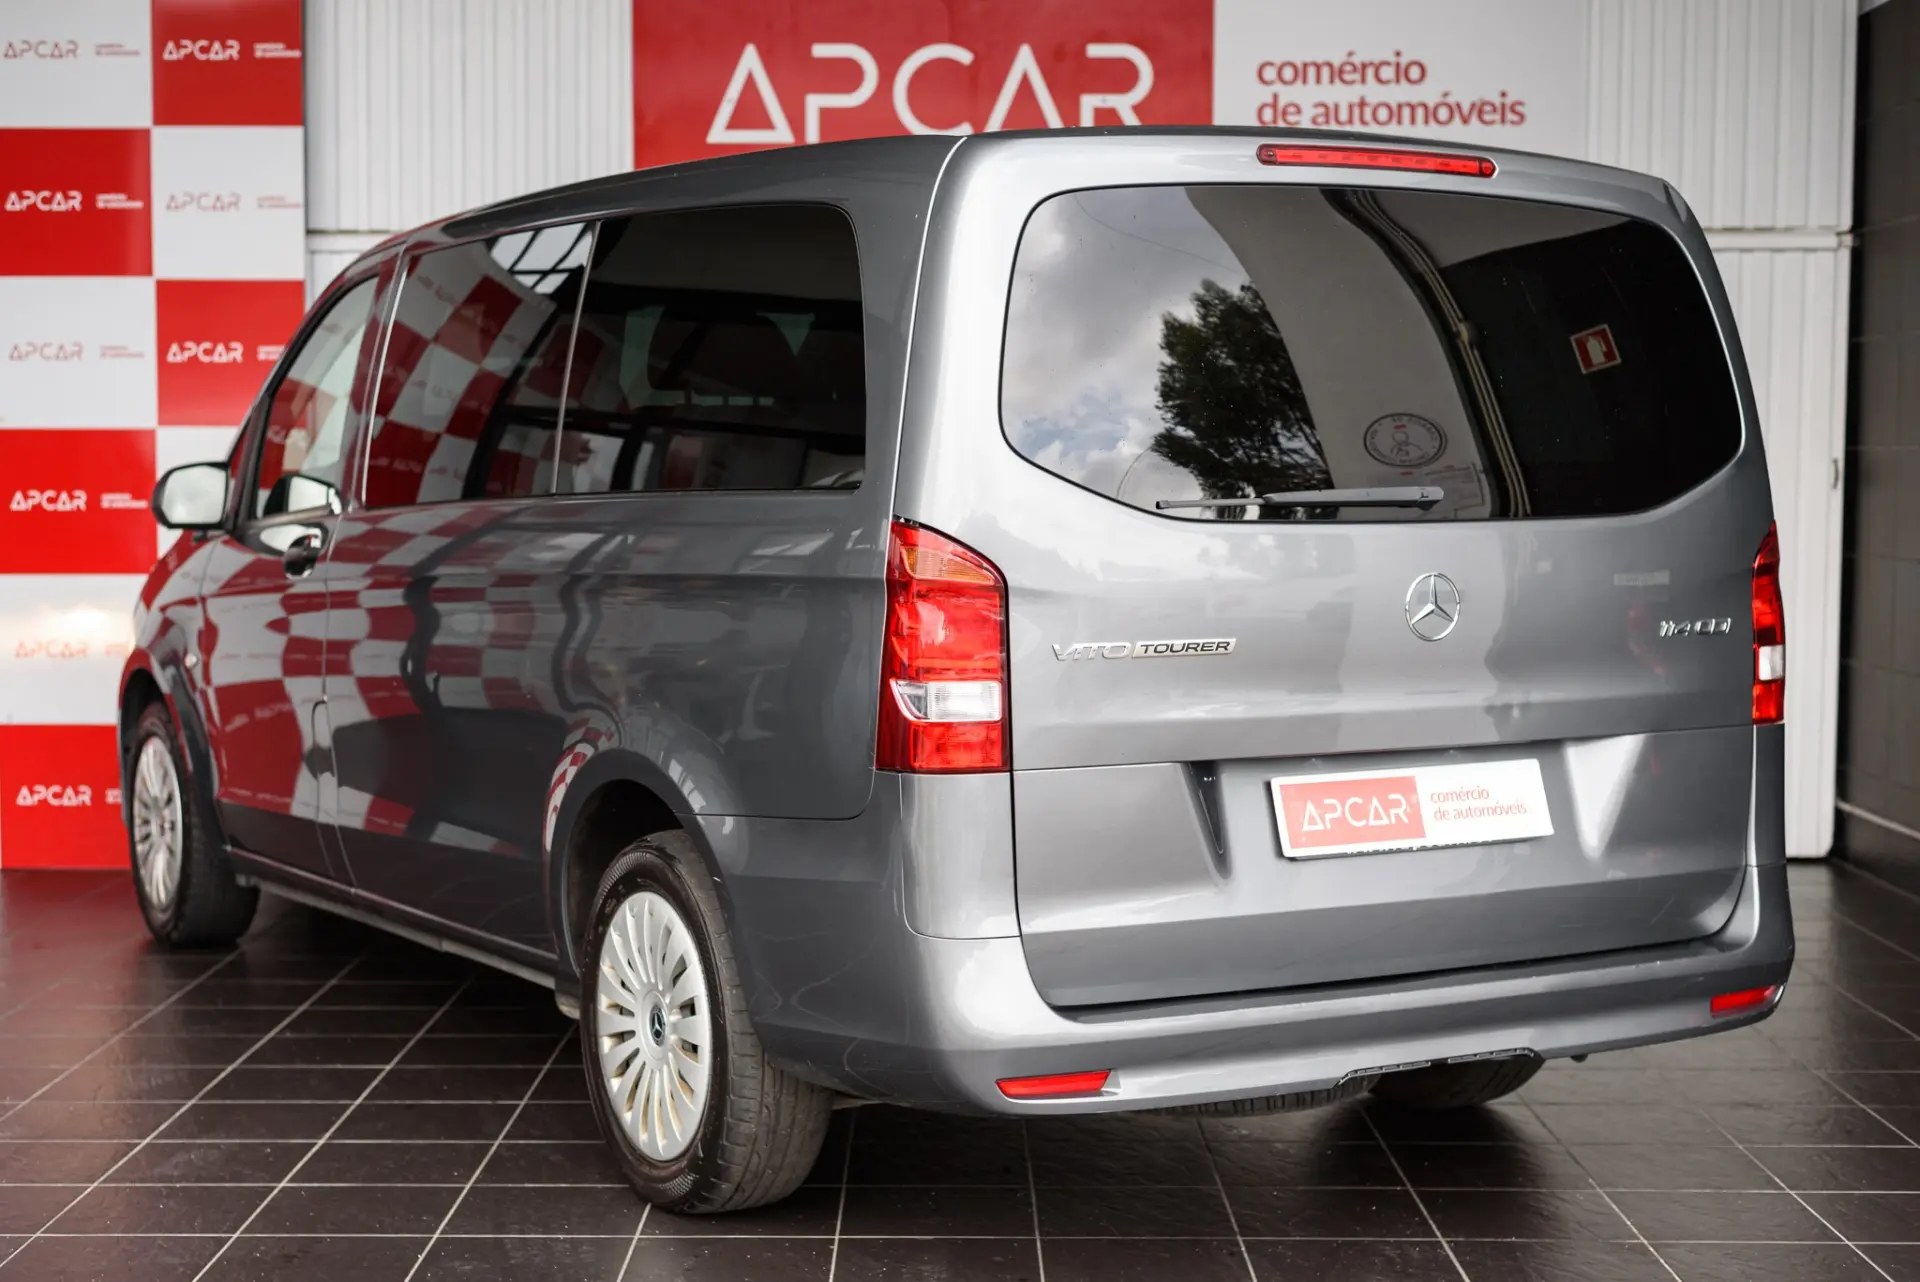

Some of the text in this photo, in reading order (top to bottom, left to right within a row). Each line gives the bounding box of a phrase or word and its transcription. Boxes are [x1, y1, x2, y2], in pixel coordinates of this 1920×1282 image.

[3, 39, 79, 60] APCAR
[162, 39, 240, 61] APCAR
[1256, 50, 1427, 86] comércio
[706, 43, 1154, 144] APCAR
[1256, 90, 1526, 127] de automóveis
[4, 190, 82, 212] APCAR
[165, 191, 241, 213] APCAR
[8, 341, 83, 362] APCAR
[166, 341, 244, 363] APCAR
[9, 489, 87, 512] APCAR
[1051, 640, 1231, 662] VITO TOURER
[15, 784, 92, 807] APCAR
[1430, 785, 1490, 803] comércio
[1301, 793, 1410, 832] APCAR
[1433, 799, 1528, 821] de automóveis
